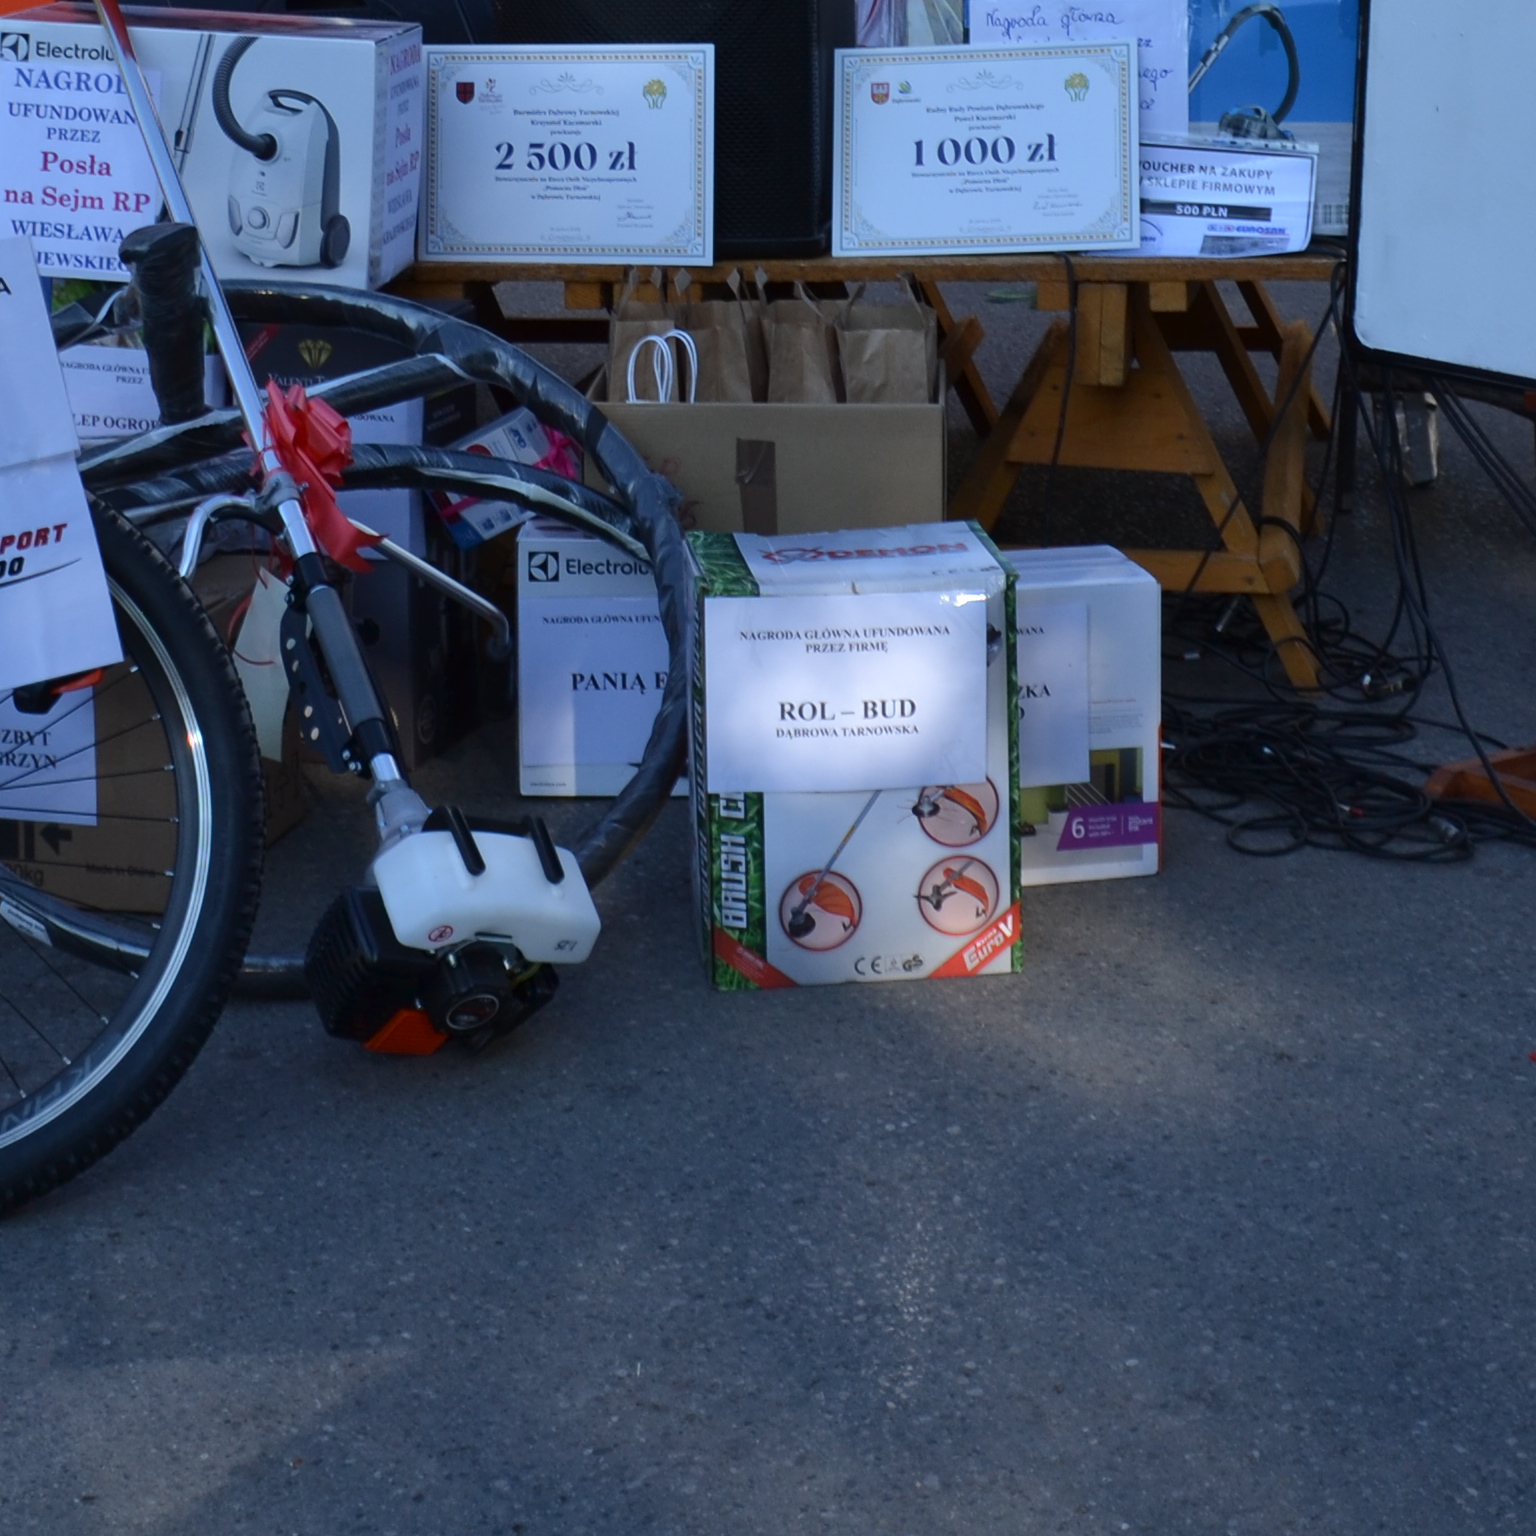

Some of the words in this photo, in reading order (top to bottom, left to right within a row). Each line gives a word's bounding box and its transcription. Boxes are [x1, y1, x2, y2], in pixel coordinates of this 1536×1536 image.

[986, 10, 1048, 39] Nagroda
[46, 128, 101, 144] PRZEZ
[495, 141, 515, 171] 2
[526, 141, 598, 171] 500
[608, 140, 638, 171] zł
[914, 139, 925, 166] 1
[936, 135, 1016, 166] 000
[1026, 133, 1058, 163] zł
[40, 150, 112, 178] Posła
[1140, 160, 1195, 175] OUCHER
[1198, 166, 1217, 177] NA
[1220, 166, 1273, 180] ZAKUPY
[1147, 176, 1198, 191] SKLEPIE
[1201, 182, 1276, 196] FIRMOWYM
[4, 187, 34, 205] na
[41, 185, 104, 213] Sejm
[113, 192, 151, 214] RP
[1175, 203, 1200, 216] 500
[1202, 205, 1229, 219] PLN
[11, 218, 126, 244] WIESŁAWA
[116, 375, 143, 385] PRZEZ
[827, 542, 969, 560] DEMON
[542, 615, 590, 625] NAGRODA
[591, 613, 634, 625] GŁÓWNA
[739, 629, 803, 643] NAGRODA
[804, 626, 862, 642] GŁÓWNA
[863, 623, 952, 640] UFUNDOWANA
[805, 641, 846, 655] PRZEZ
[849, 639, 889, 655] FIRMĘ
[571, 671, 647, 696] PANIĄ
[778, 700, 837, 723] ROL
[862, 698, 918, 721] BUD
[775, 725, 840, 741] DĄBROWA
[842, 723, 920, 738] TARNOWSKA
[1070, 816, 1086, 839] 6
[719, 833, 749, 930] BRUSH
